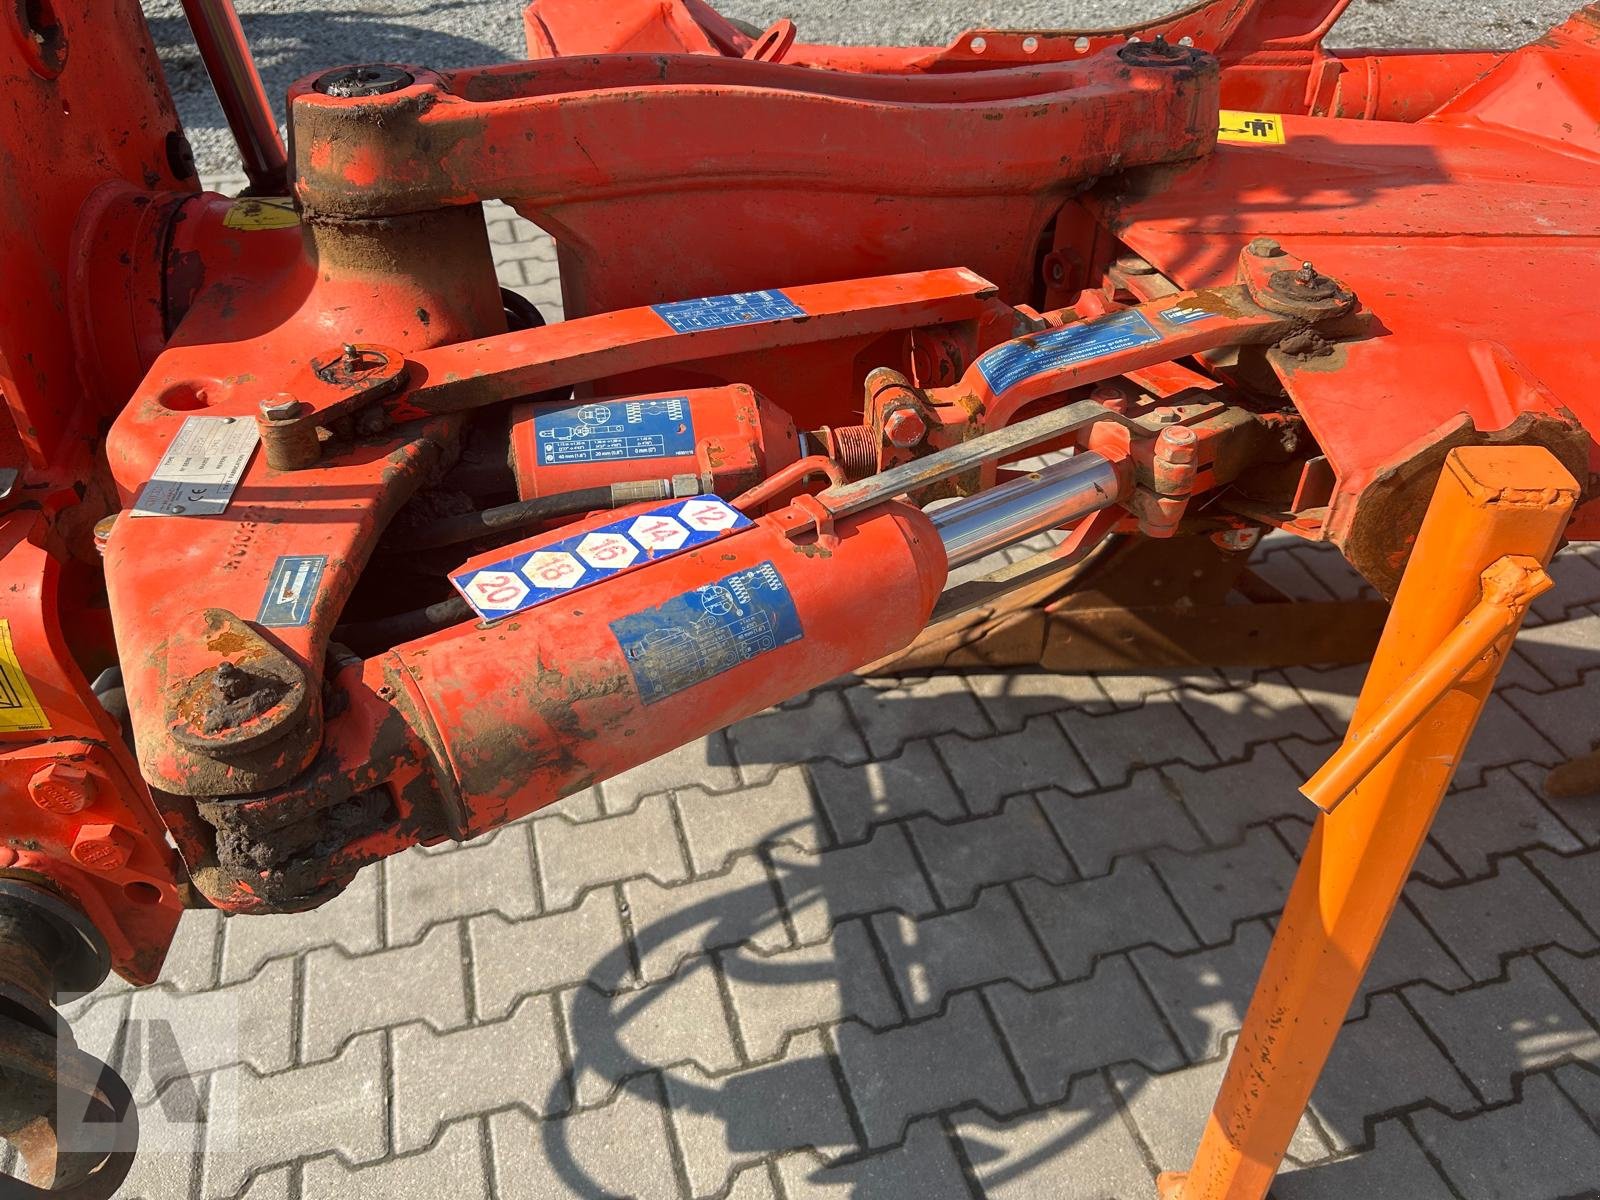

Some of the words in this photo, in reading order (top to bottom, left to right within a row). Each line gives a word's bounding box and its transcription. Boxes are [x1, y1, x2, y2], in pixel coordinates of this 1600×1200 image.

[188, 488, 207, 501] CE
[691, 504, 727, 525] 12
[640, 520, 680, 542] 14
[588, 538, 628, 562] 16
[534, 556, 575, 582] 18
[476, 575, 521, 604] 20
